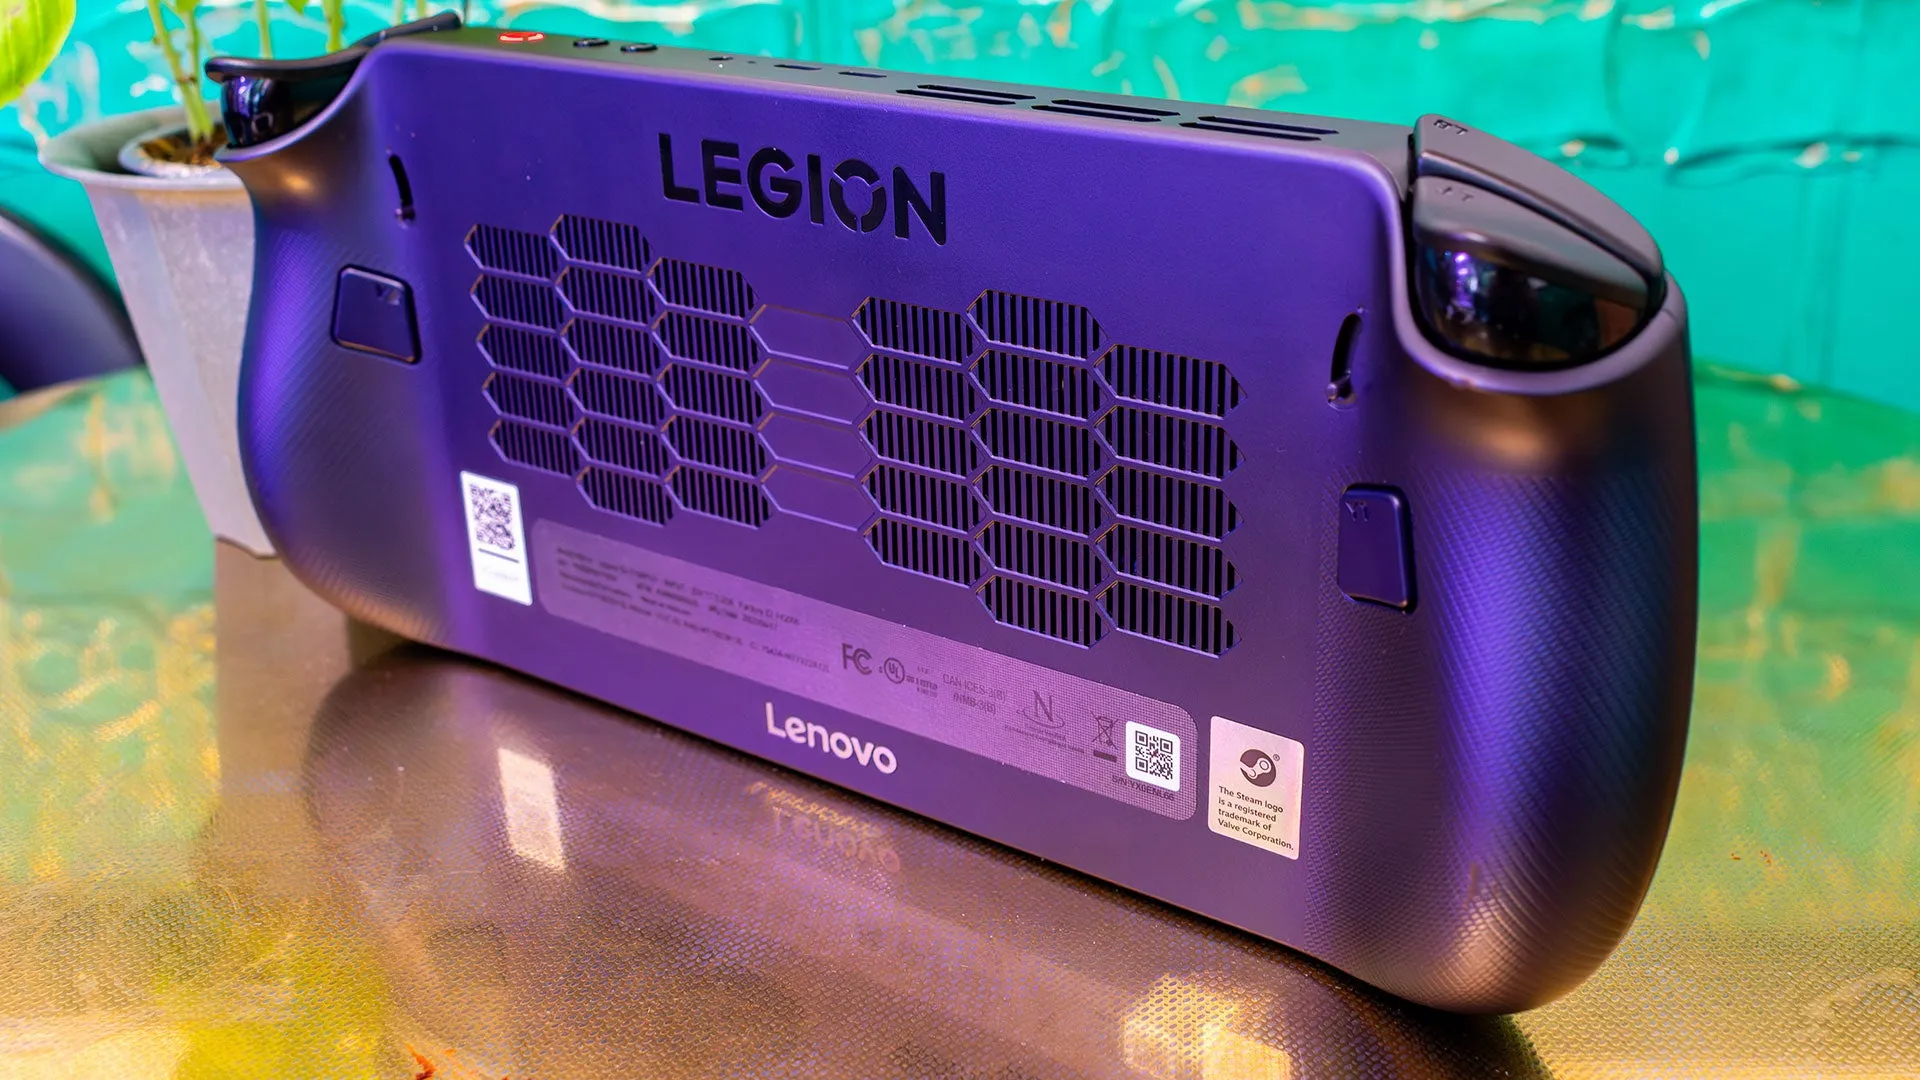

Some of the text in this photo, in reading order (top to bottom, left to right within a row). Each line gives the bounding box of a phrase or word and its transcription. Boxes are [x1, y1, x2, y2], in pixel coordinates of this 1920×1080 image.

[658, 132, 947, 247] LEGION
[765, 702, 898, 775] Lenovo
[1218, 785, 1284, 813] The Steam logo
[1218, 797, 1225, 805] is
[1234, 803, 1277, 822] registered
[1217, 818, 1294, 851] Valve Corporation.
[1218, 808, 1272, 831] trademark of
